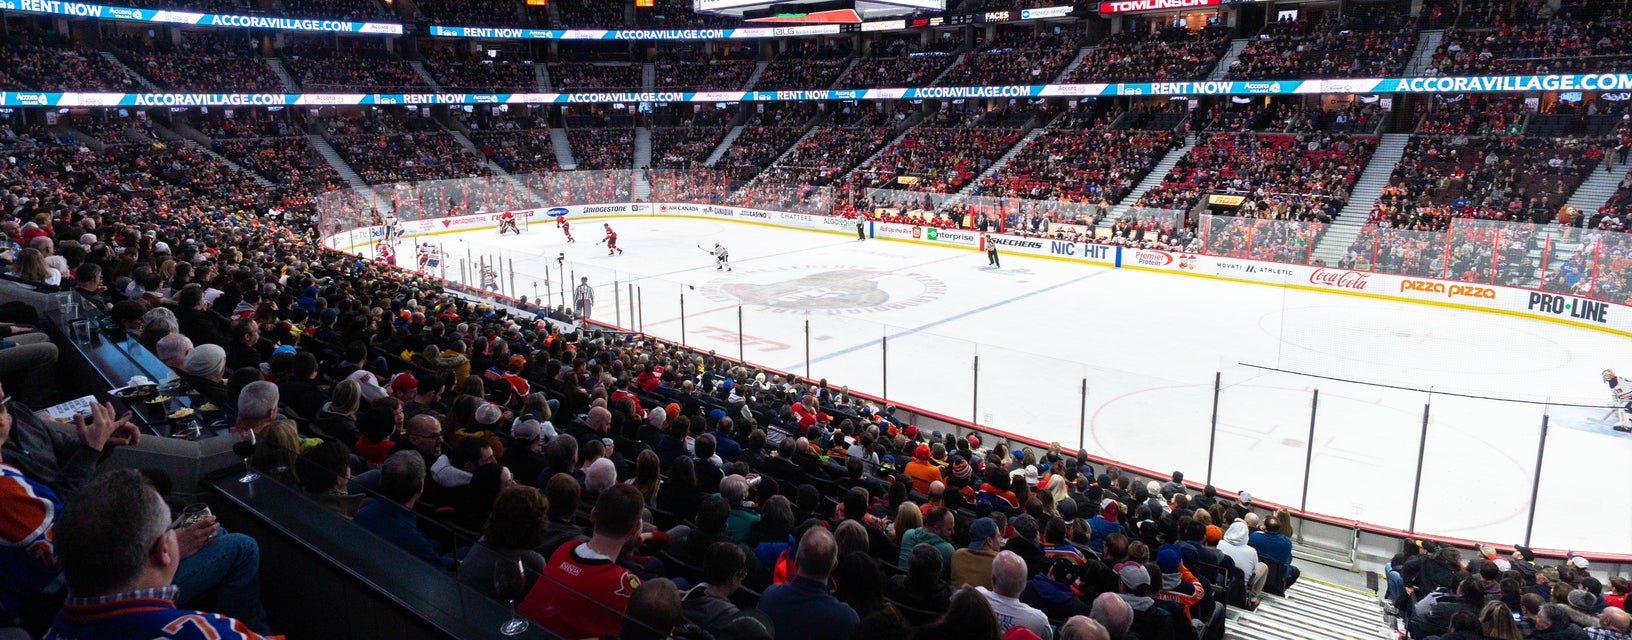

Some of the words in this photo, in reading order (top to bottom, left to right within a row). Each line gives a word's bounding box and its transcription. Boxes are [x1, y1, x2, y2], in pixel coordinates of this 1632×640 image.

[22, 0, 60, 13] RENT
[64, 4, 102, 17] NOW
[985, 11, 1009, 19] FACES
[212, 15, 353, 32] ACCORAVILLAGE.COM
[463, 27, 491, 37] RENT
[494, 28, 523, 38] NOW
[615, 29, 724, 39] ACCORAVILLAGE.COM
[1152, 82, 1190, 94] RENT
[1193, 82, 1234, 94] NOW
[1395, 74, 1632, 92] ACCORAVILLAGE.COM
[568, 92, 684, 103] ACCORAVILLAGE.COM
[776, 91, 804, 100] RENT
[805, 90, 830, 99] NOW
[914, 86, 1031, 98] ACCORAVILLAGE.COM
[135, 93, 286, 105] ACCORAVILLAGE.COM
[403, 94, 434, 103] RENT
[437, 94, 466, 103] NOW
[583, 205, 627, 213] BRIDGESTONE
[750, 210, 767, 219] CASINO
[780, 212, 812, 222] CHATTERS
[371, 227, 385, 237] Bell
[930, 230, 974, 242] enterprise
[990, 237, 1043, 249] SKECHERS
[1051, 240, 1075, 256] NIC
[1084, 244, 1110, 260] HIT
[1135, 251, 1165, 261] Premier
[1138, 258, 1161, 267] Protein
[1216, 262, 1243, 270] MOVATI
[1259, 268, 1294, 276] ATHLETIC
[1309, 267, 1372, 290] Coca-Cola
